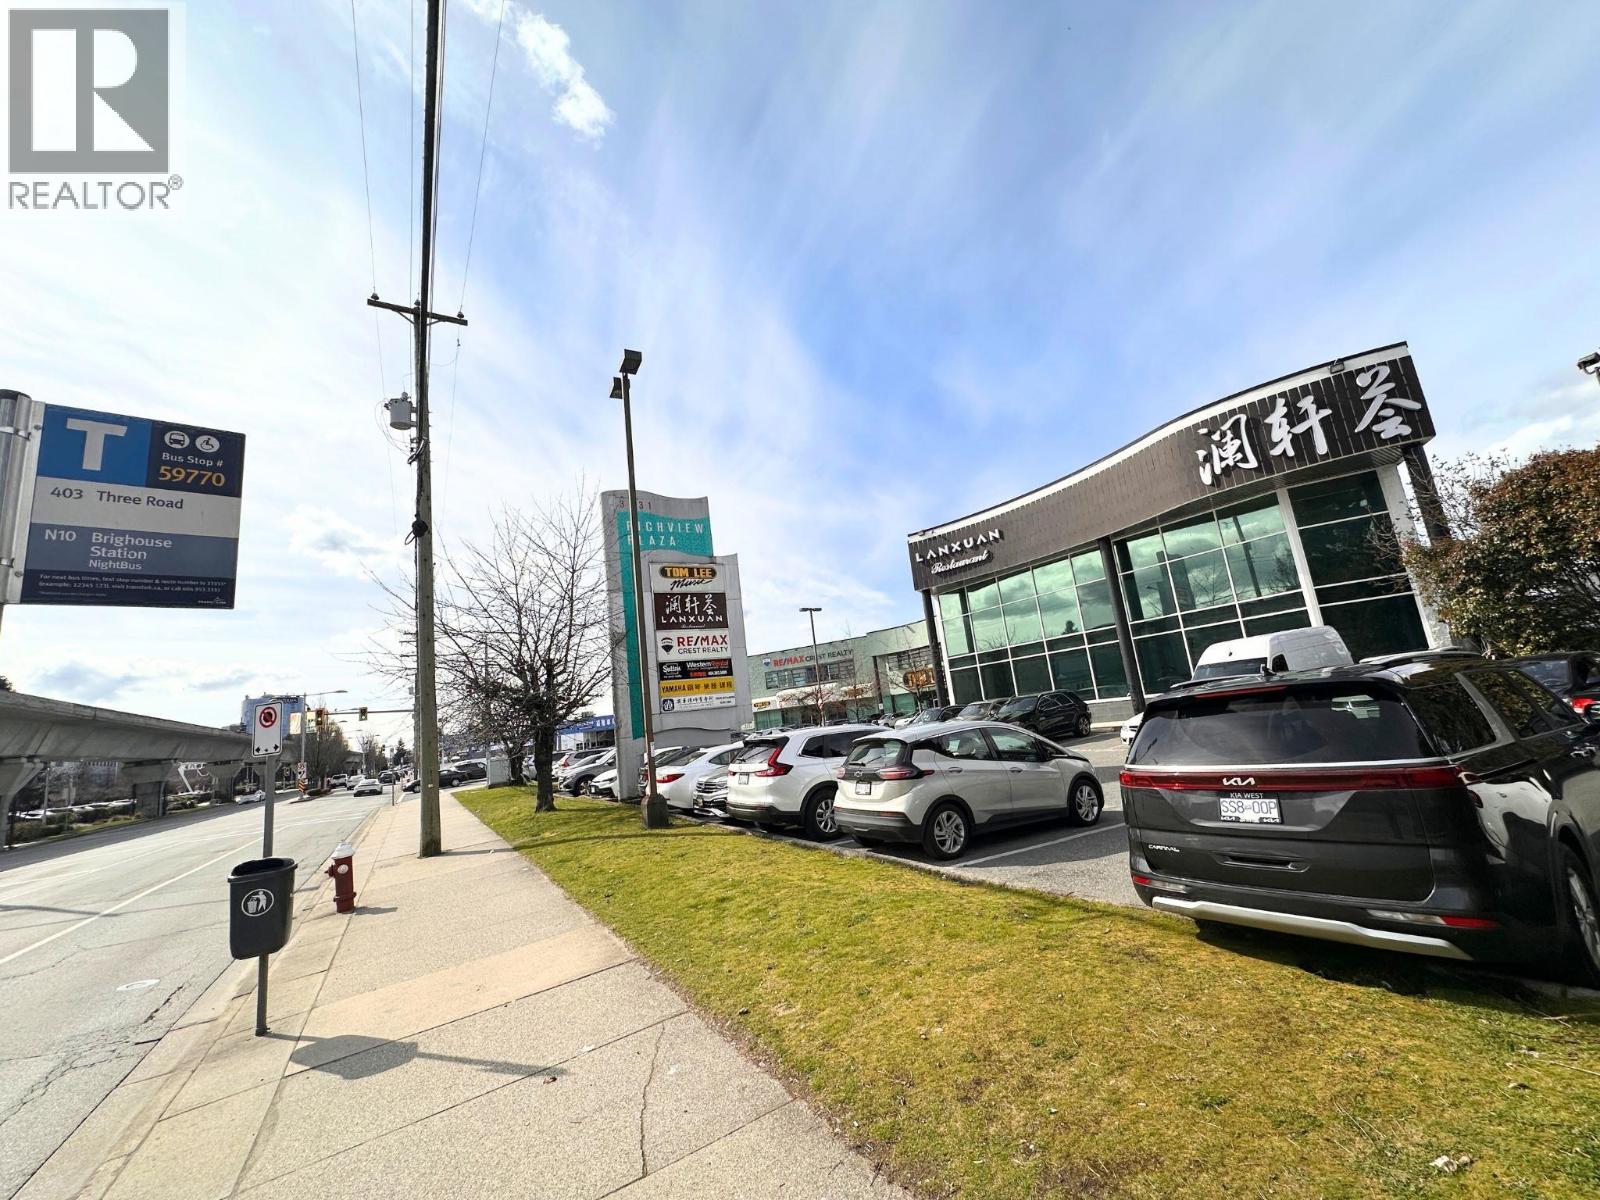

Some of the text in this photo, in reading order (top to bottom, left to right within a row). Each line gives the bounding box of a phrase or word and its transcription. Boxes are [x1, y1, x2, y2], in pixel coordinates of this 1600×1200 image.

[66, 417, 128, 471] T
[162, 452, 224, 468] Bus Stop #
[158, 465, 226, 487] 59770
[50, 486, 184, 509] 403 Three Road
[619, 499, 652, 510] 331
[44, 528, 173, 548] N10 Brighouse
[915, 528, 1001, 563] LANXUAN
[89, 545, 147, 560] Station
[88, 558, 142, 571] NightBus
[931, 549, 990, 575] Restaurant
[665, 567, 712, 577] TOM LEE
[661, 615, 723, 624] LANXUAN
[677, 634, 728, 648] RE/MAX
[702, 646, 728, 654] REALTY
[773, 655, 805, 668] RE/MAX
[828, 649, 854, 659] REALTY
[661, 684, 686, 694] YAMAHA
